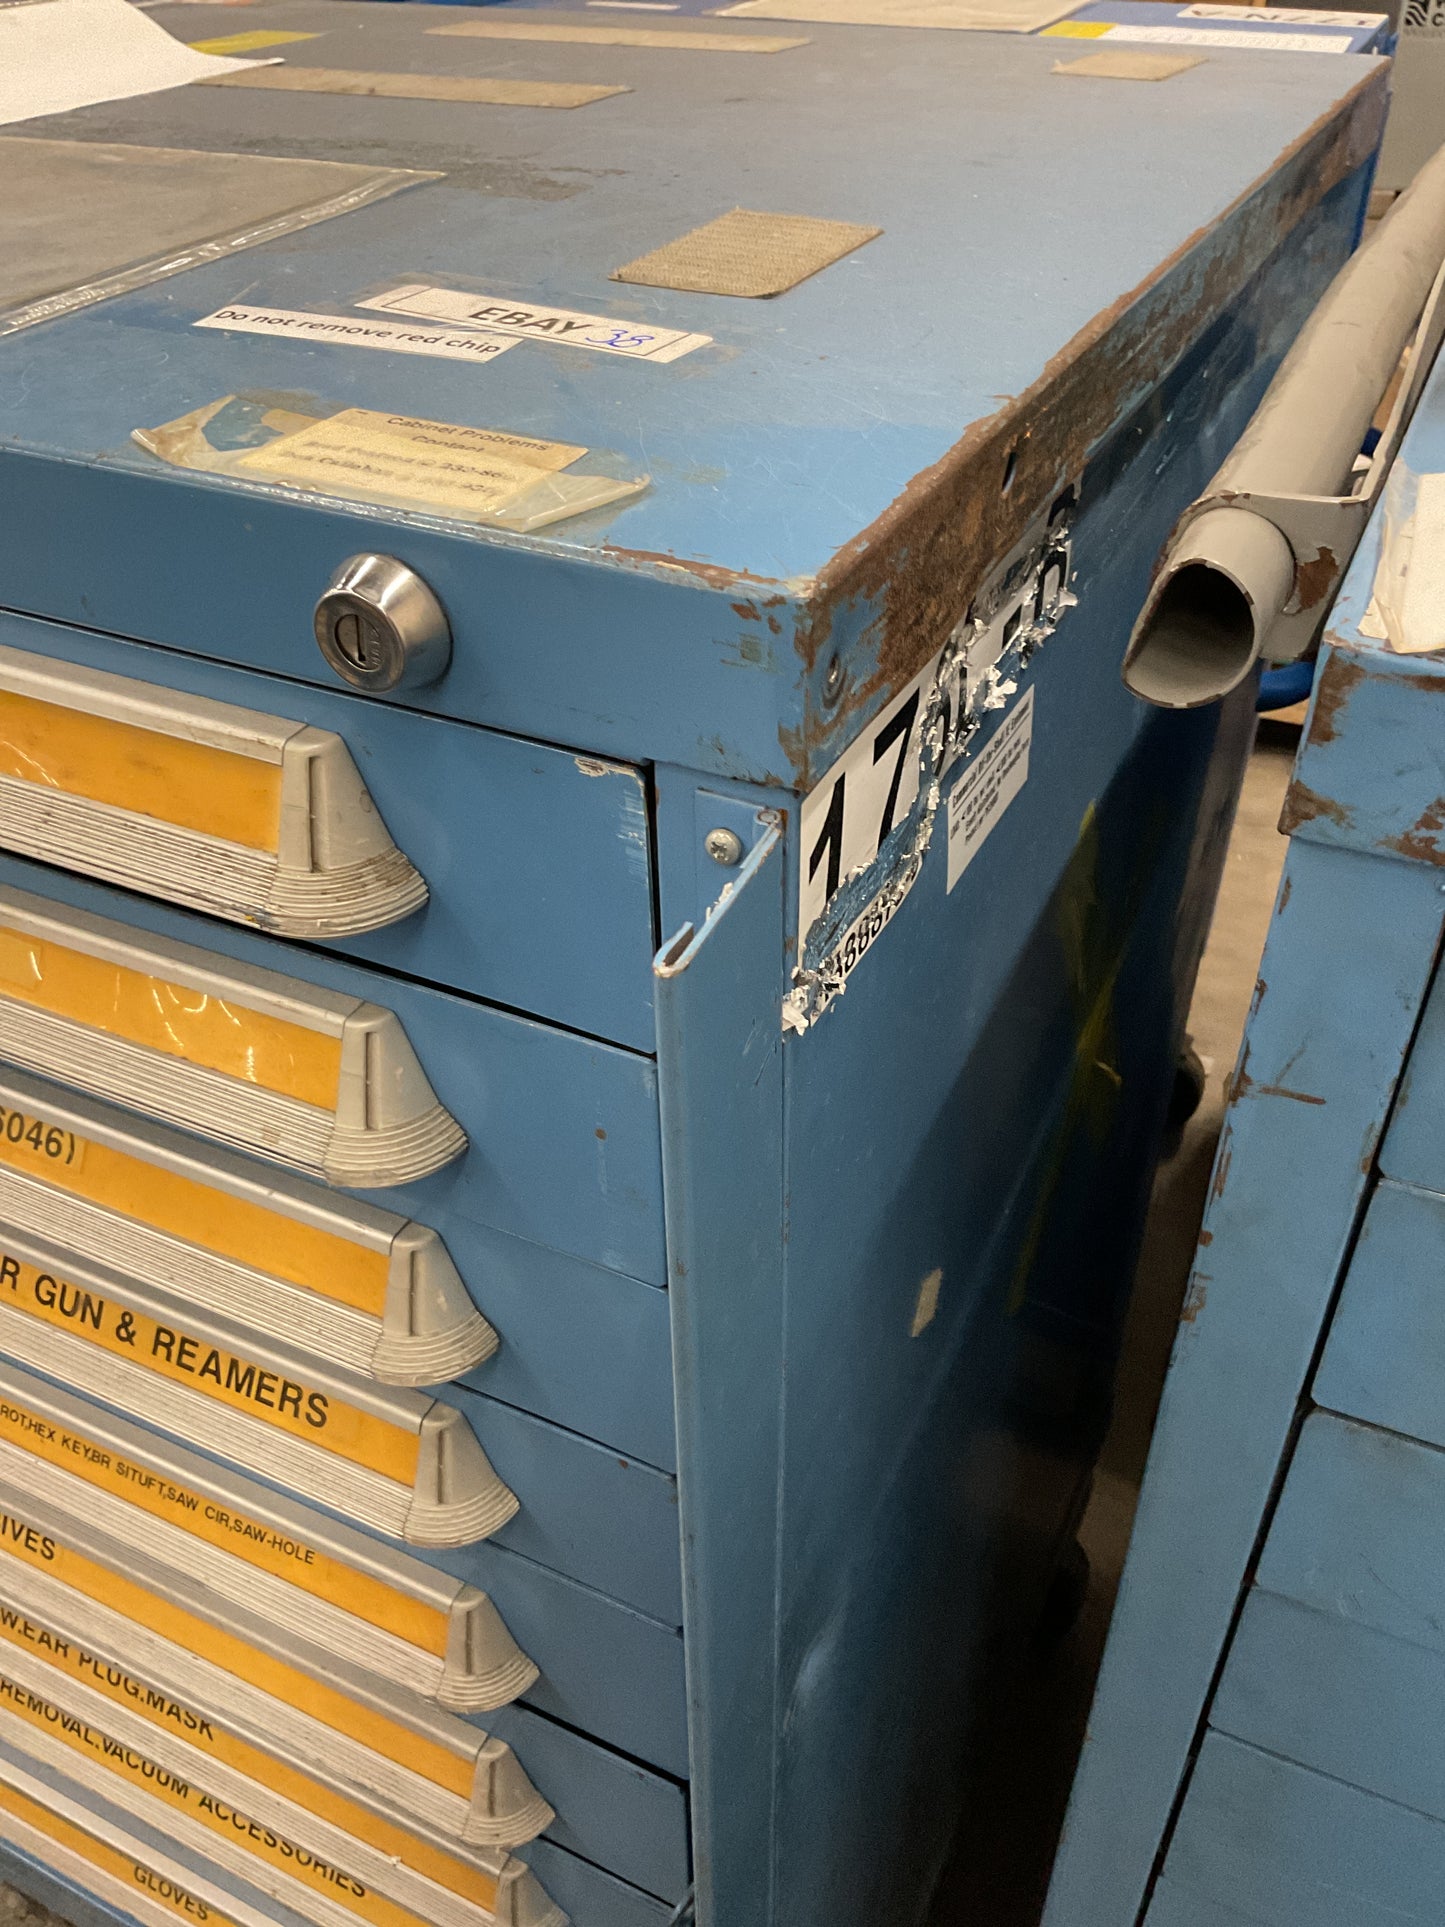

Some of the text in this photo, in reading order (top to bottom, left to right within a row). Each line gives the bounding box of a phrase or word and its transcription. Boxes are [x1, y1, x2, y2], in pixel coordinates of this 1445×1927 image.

[214, 310, 501, 354] Do not remove red chip
[468, 307, 592, 334] EBAY
[585, 329, 654, 348] 38
[387, 417, 550, 451] Cabinet Problems
[411, 435, 485, 453] Contact
[34, 1274, 104, 1330] GUN
[115, 1311, 137, 1347] &
[152, 1327, 329, 1428] REAMERS
[1, 1515, 56, 1561] IVES
[204, 1505, 316, 1566] CIR,SAW-HOLE
[134, 1866, 208, 1920] GLOVES
